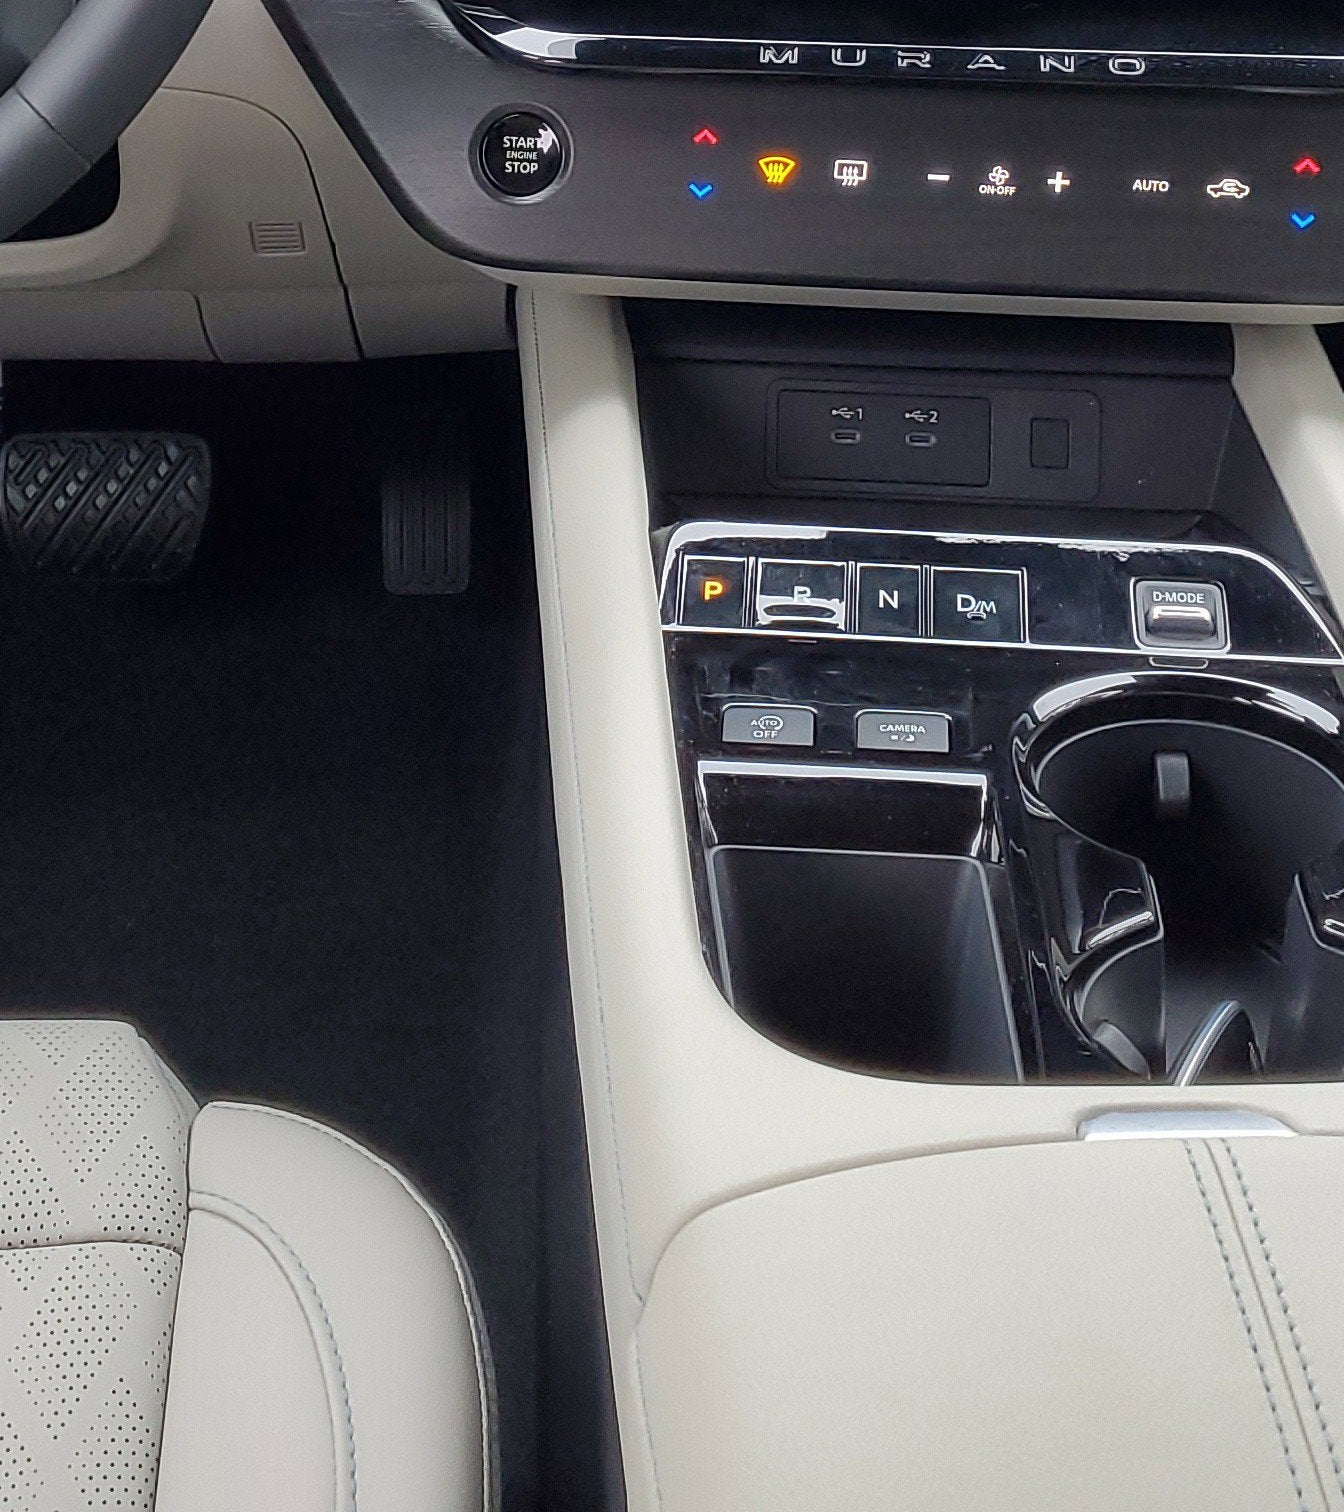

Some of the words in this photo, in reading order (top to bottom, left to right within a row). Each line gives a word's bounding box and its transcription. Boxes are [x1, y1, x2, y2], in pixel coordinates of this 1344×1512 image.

[760, 46, 1146, 76] MURANO
[503, 136, 544, 149] START
[506, 150, 538, 160] ENGINE
[505, 161, 538, 174] STOP
[1132, 180, 1169, 192] AUTO
[856, 408, 864, 420] 1
[928, 411, 939, 423] 2
[704, 581, 723, 600] P
[793, 586, 811, 603] R
[879, 590, 899, 609] N
[1152, 591, 1205, 604] D-MODE
[753, 730, 778, 739] OFF
[879, 724, 926, 734] CAMERA
